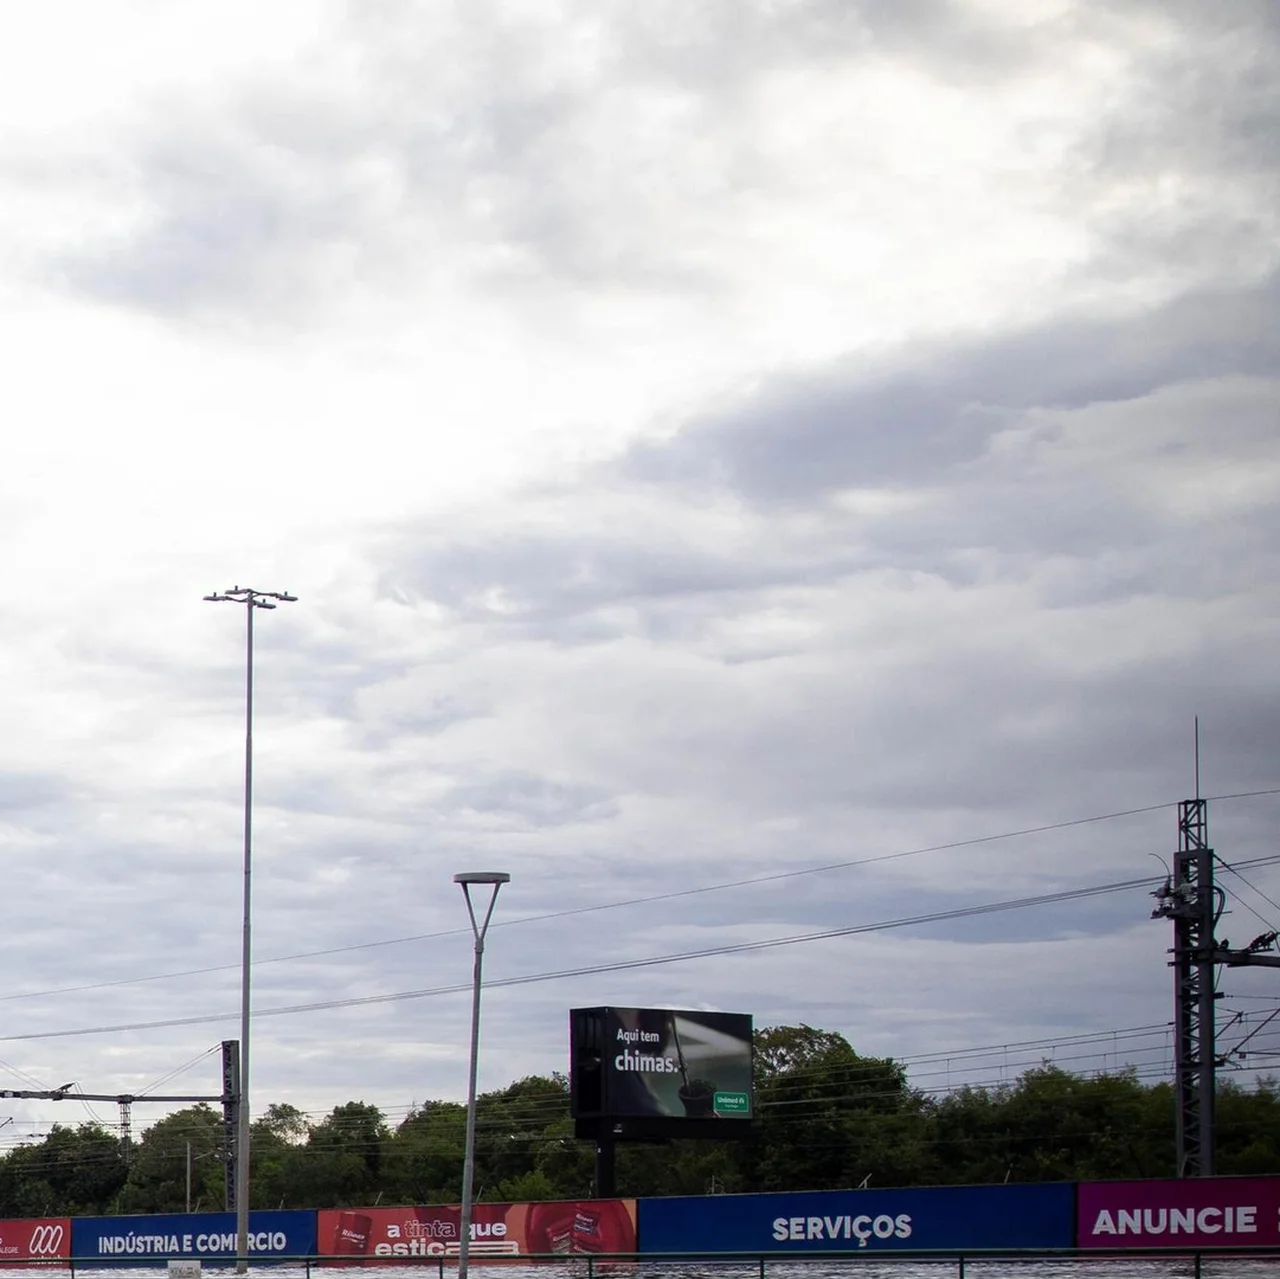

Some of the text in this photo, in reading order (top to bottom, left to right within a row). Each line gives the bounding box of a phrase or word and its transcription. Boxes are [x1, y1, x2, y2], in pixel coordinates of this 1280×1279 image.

[617, 1028, 659, 1044] Aqui tem
[615, 1049, 679, 1073] chimas.
[387, 1224, 401, 1237] a
[405, 1219, 456, 1237] tinta
[772, 1214, 913, 1247] SERVIÇOS
[1092, 1206, 1257, 1235] ANUNCIE
[98, 1231, 180, 1253] INDÚSTRIA
[183, 1234, 193, 1252] E
